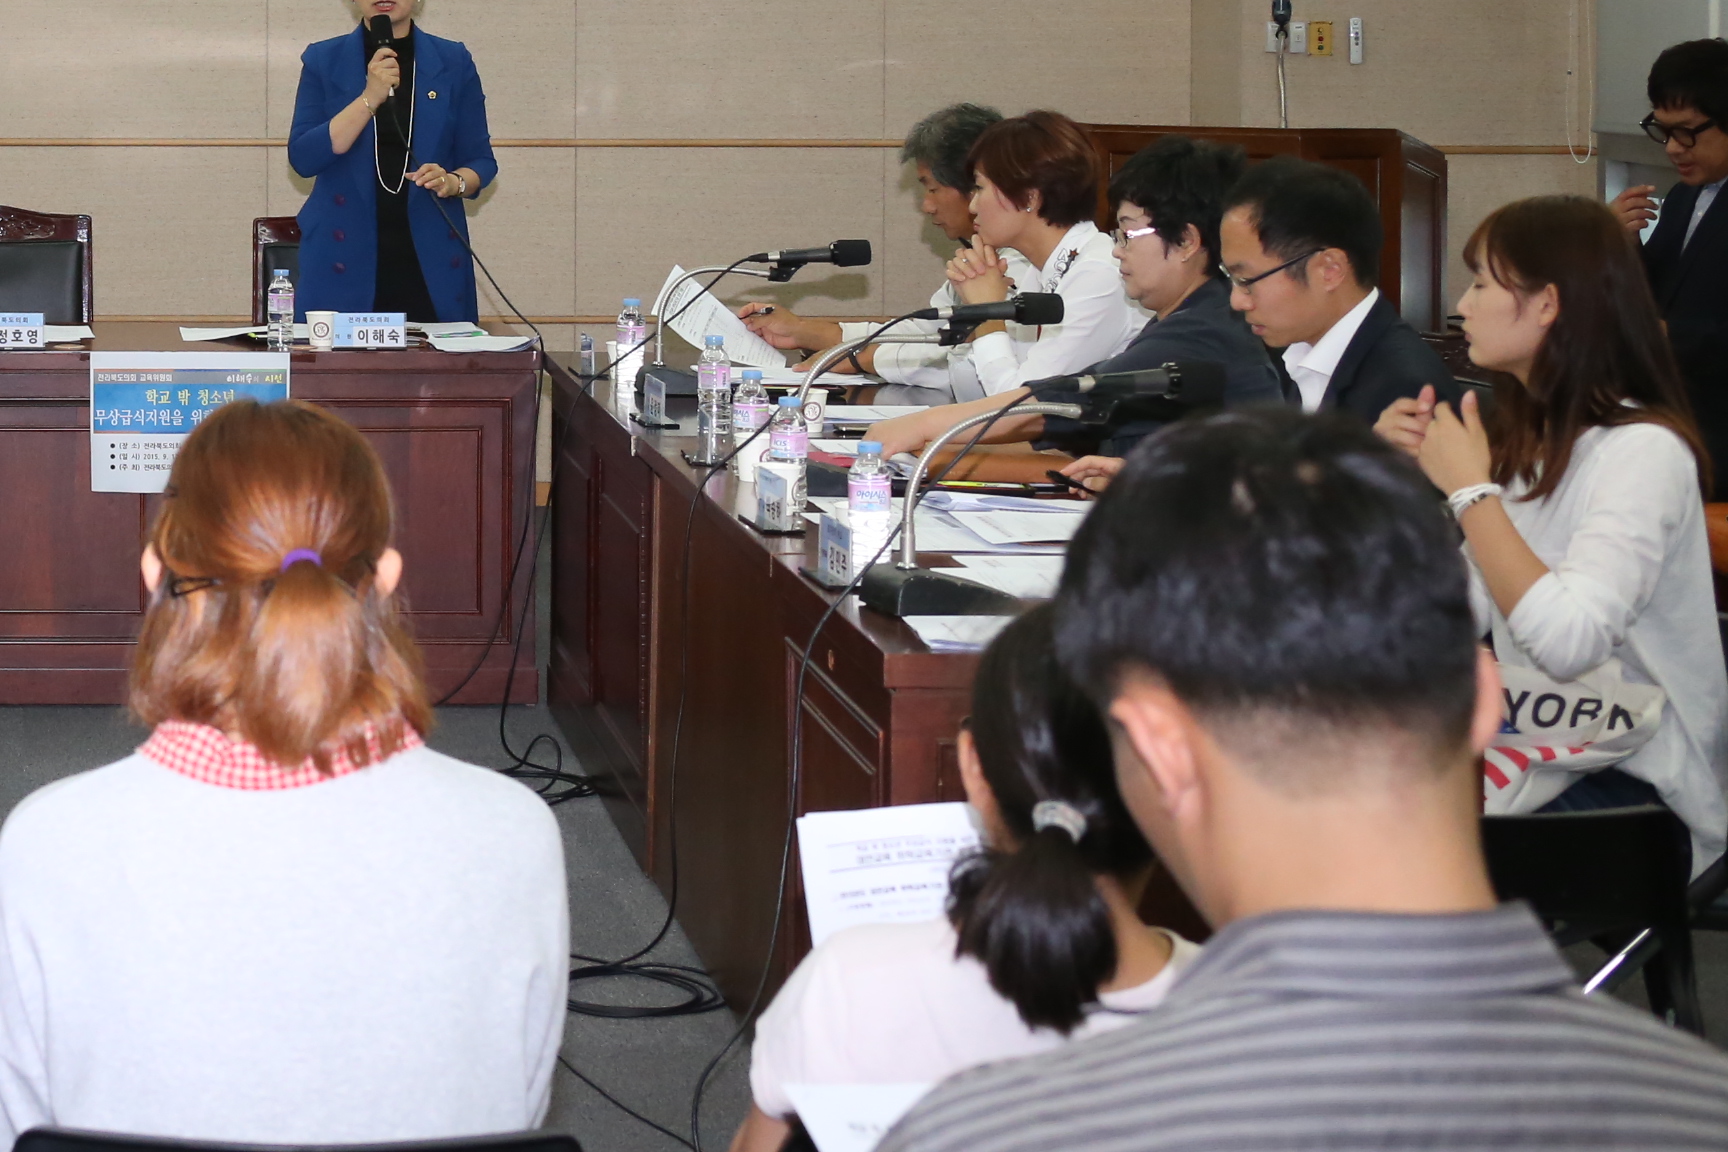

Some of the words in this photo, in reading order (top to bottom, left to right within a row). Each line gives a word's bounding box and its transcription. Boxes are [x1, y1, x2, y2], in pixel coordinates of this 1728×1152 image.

[357, 328, 401, 345] 이해숙
[97, 373, 137, 382] 전라북도의회
[140, 373, 173, 382] 교육위원회
[265, 373, 283, 384] 시선
[145, 389, 171, 406] 학교
[177, 389, 191, 406] 밖
[94, 409, 184, 427] 무상급식지원을
[856, 489, 887, 500] 아이시스
[1503, 688, 1635, 731] YORK
